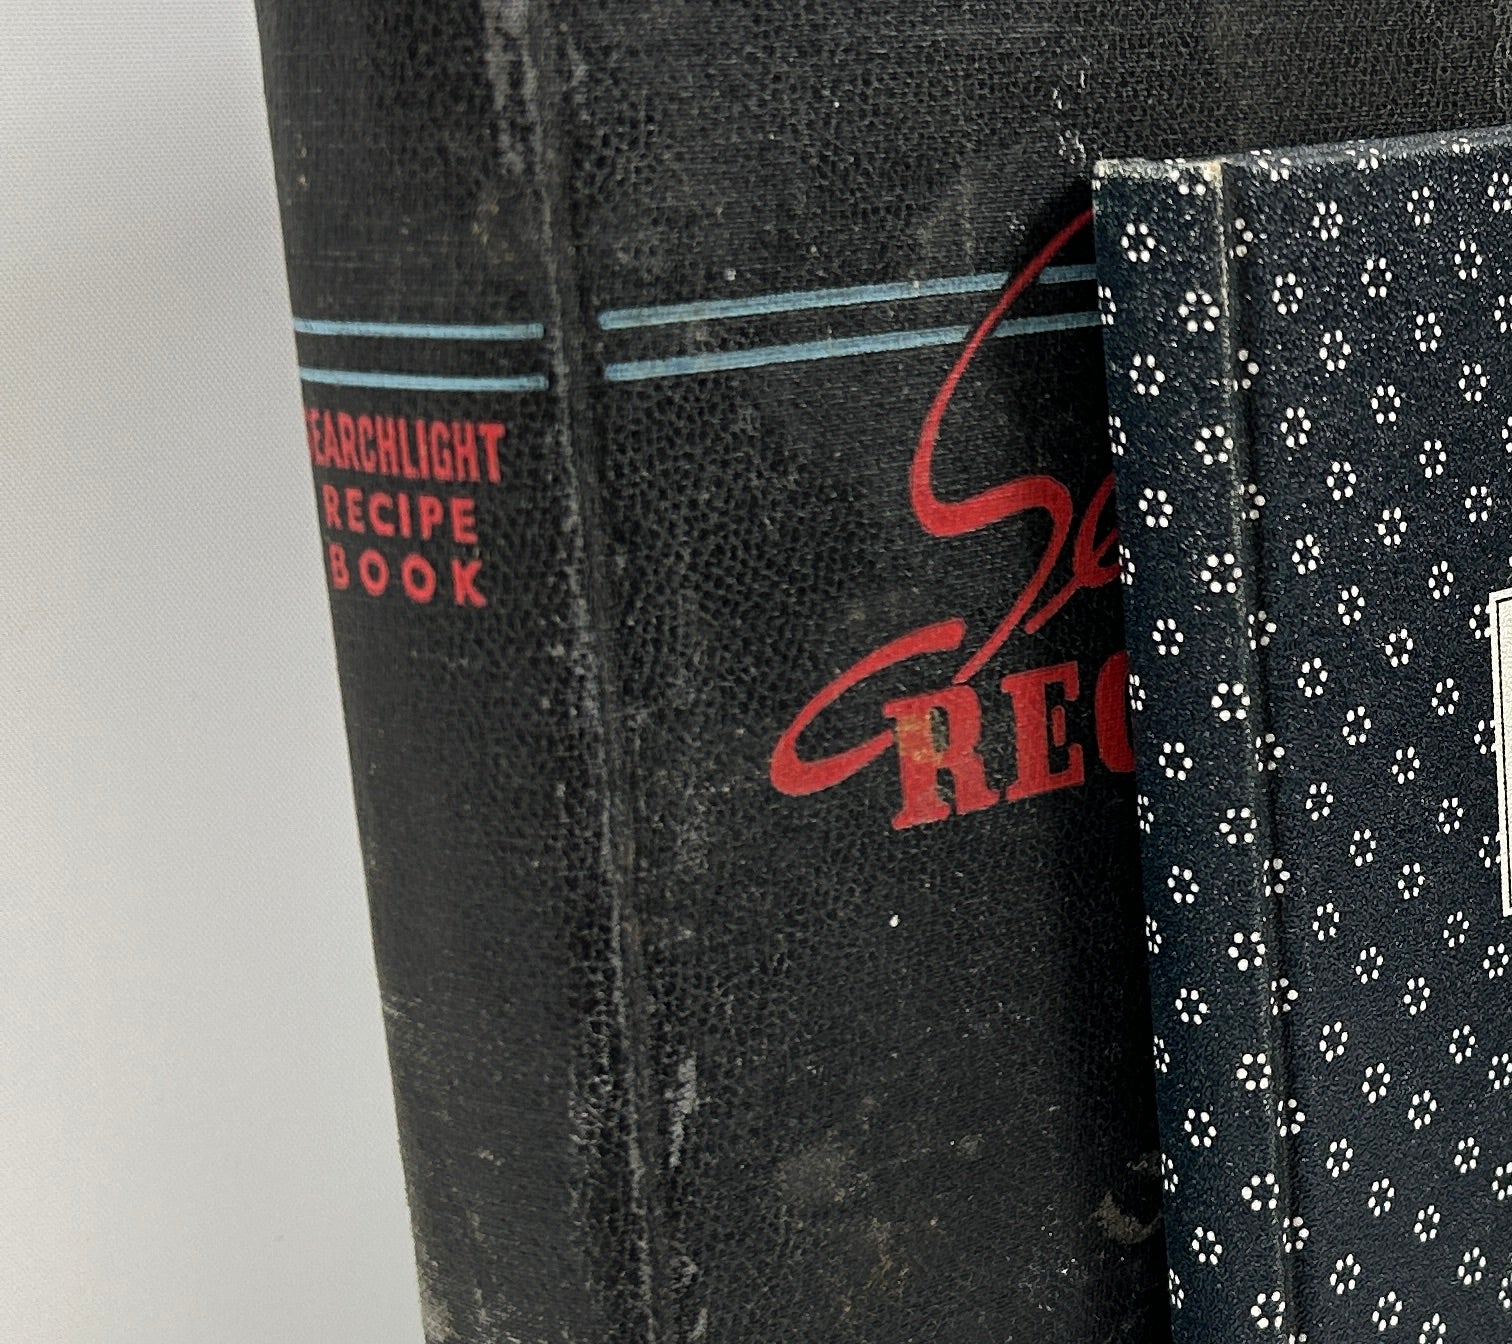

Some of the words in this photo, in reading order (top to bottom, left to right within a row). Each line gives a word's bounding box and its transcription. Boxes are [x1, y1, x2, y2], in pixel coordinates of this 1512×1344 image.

[304, 407, 505, 484] EARCHLIGHT
[321, 483, 478, 544] RECIPE
[327, 542, 488, 607] BOOK
